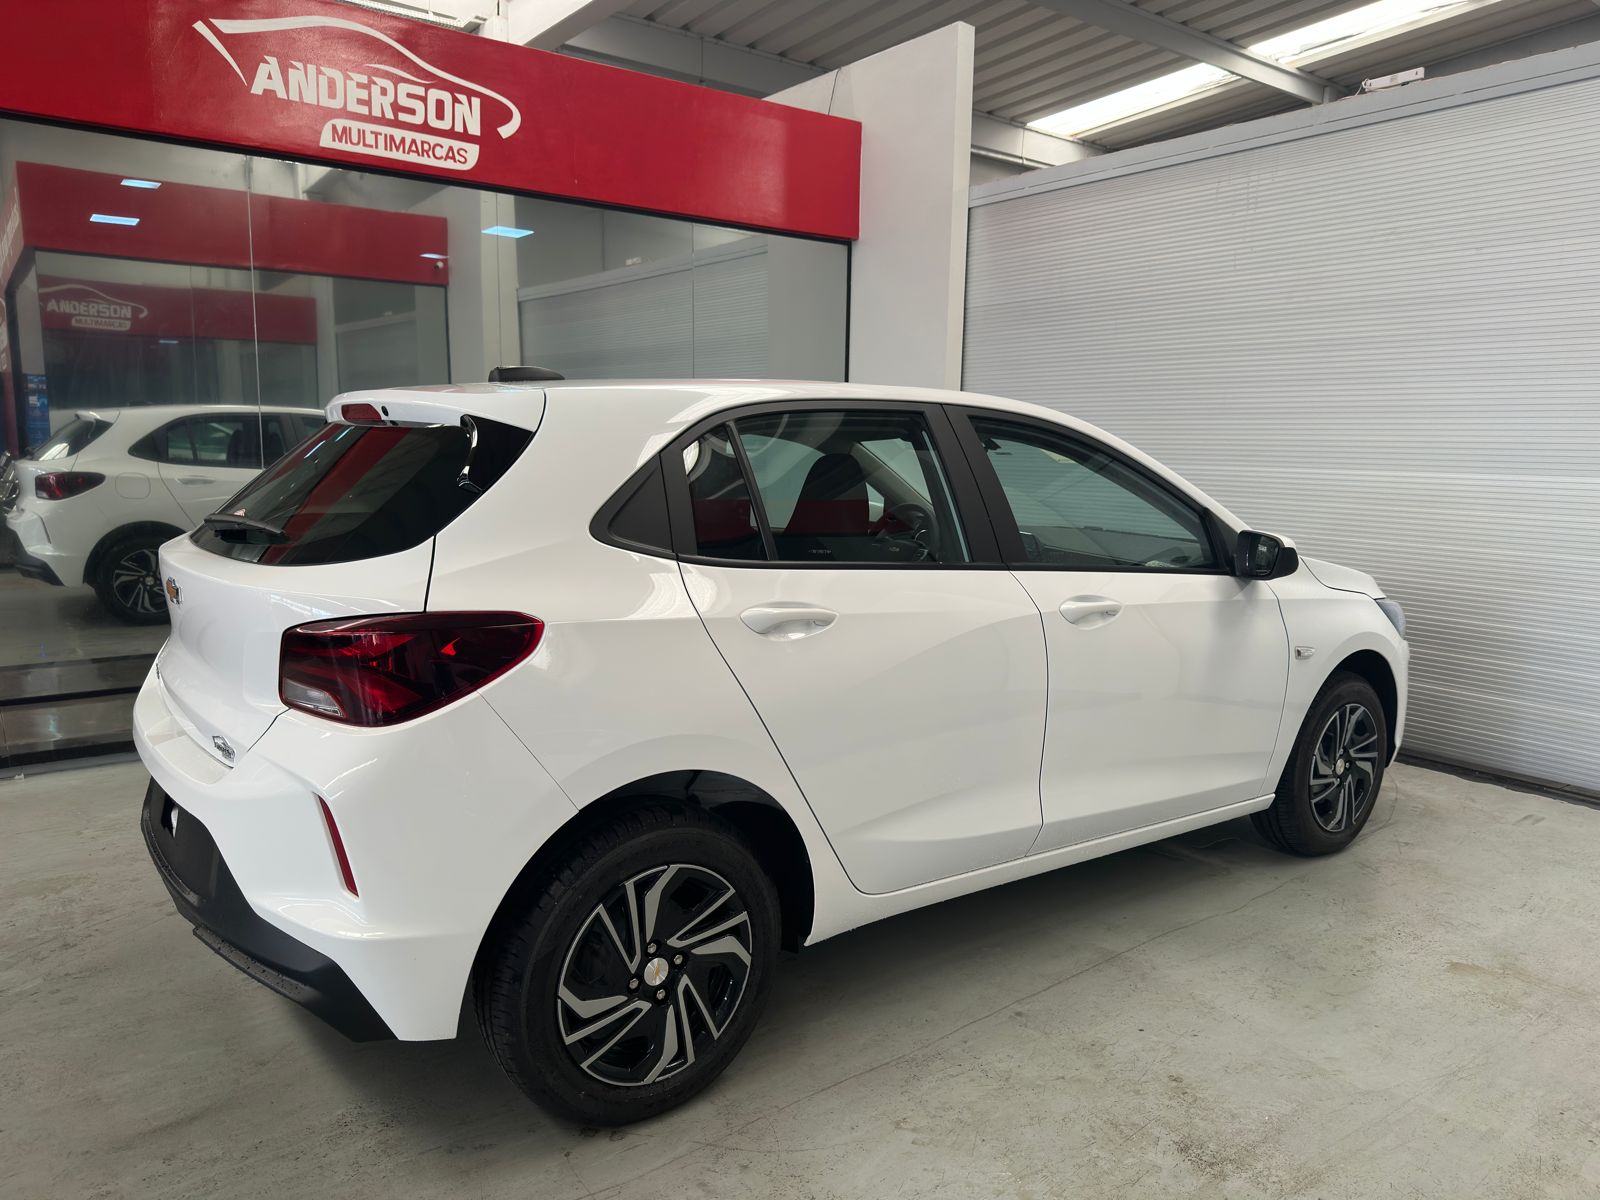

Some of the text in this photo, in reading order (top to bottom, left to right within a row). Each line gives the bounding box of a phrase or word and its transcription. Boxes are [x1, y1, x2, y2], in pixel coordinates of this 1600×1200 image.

[250, 55, 481, 137] ANDERSON
[331, 123, 468, 164] MULTIMARCAS
[46, 299, 132, 318] ANDERSON
